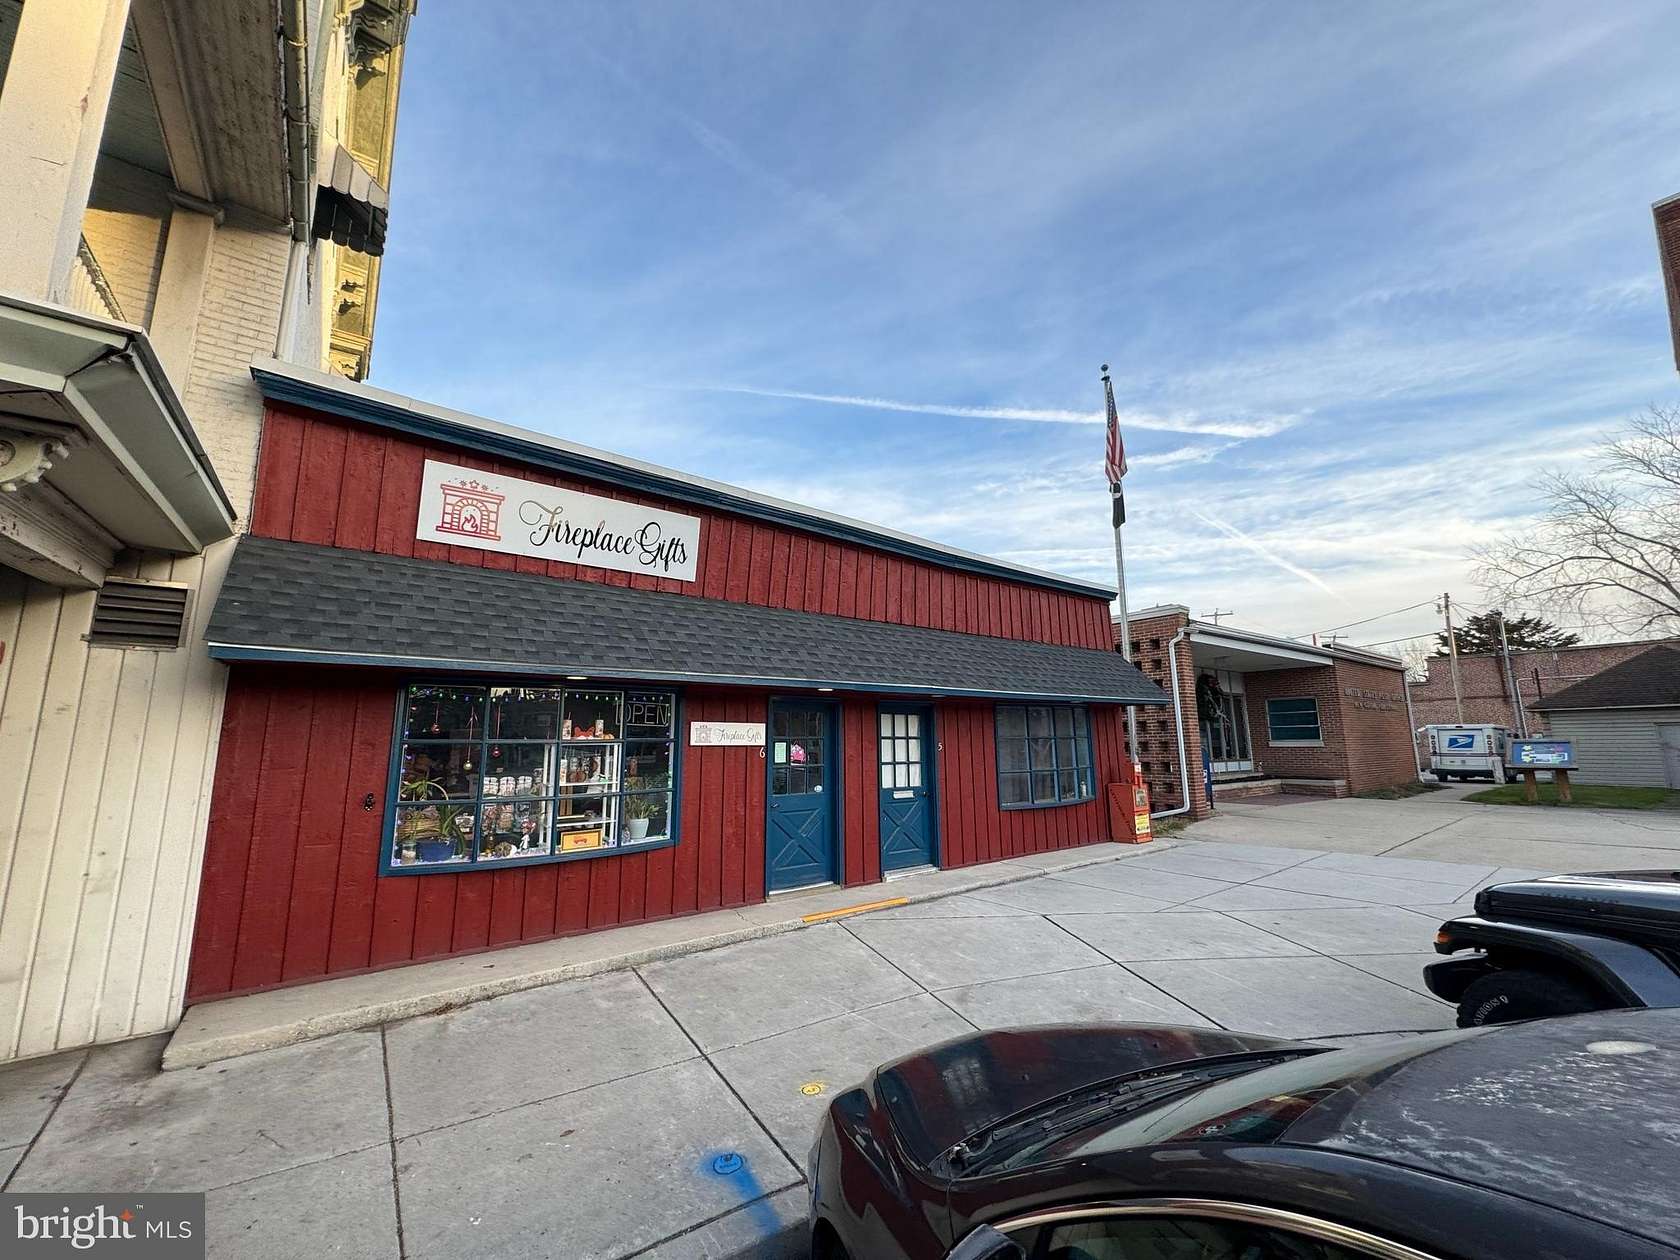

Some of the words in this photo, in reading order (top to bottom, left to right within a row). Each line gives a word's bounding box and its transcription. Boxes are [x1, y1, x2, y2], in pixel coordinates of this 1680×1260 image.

[519, 500, 635, 558] Fireplace
[634, 521, 688, 572] Gifts
[619, 703, 668, 724] OPEN
[714, 727, 746, 744] Fireplace
[746, 727, 762, 744] Gifts
[759, 747, 766, 758] 6
